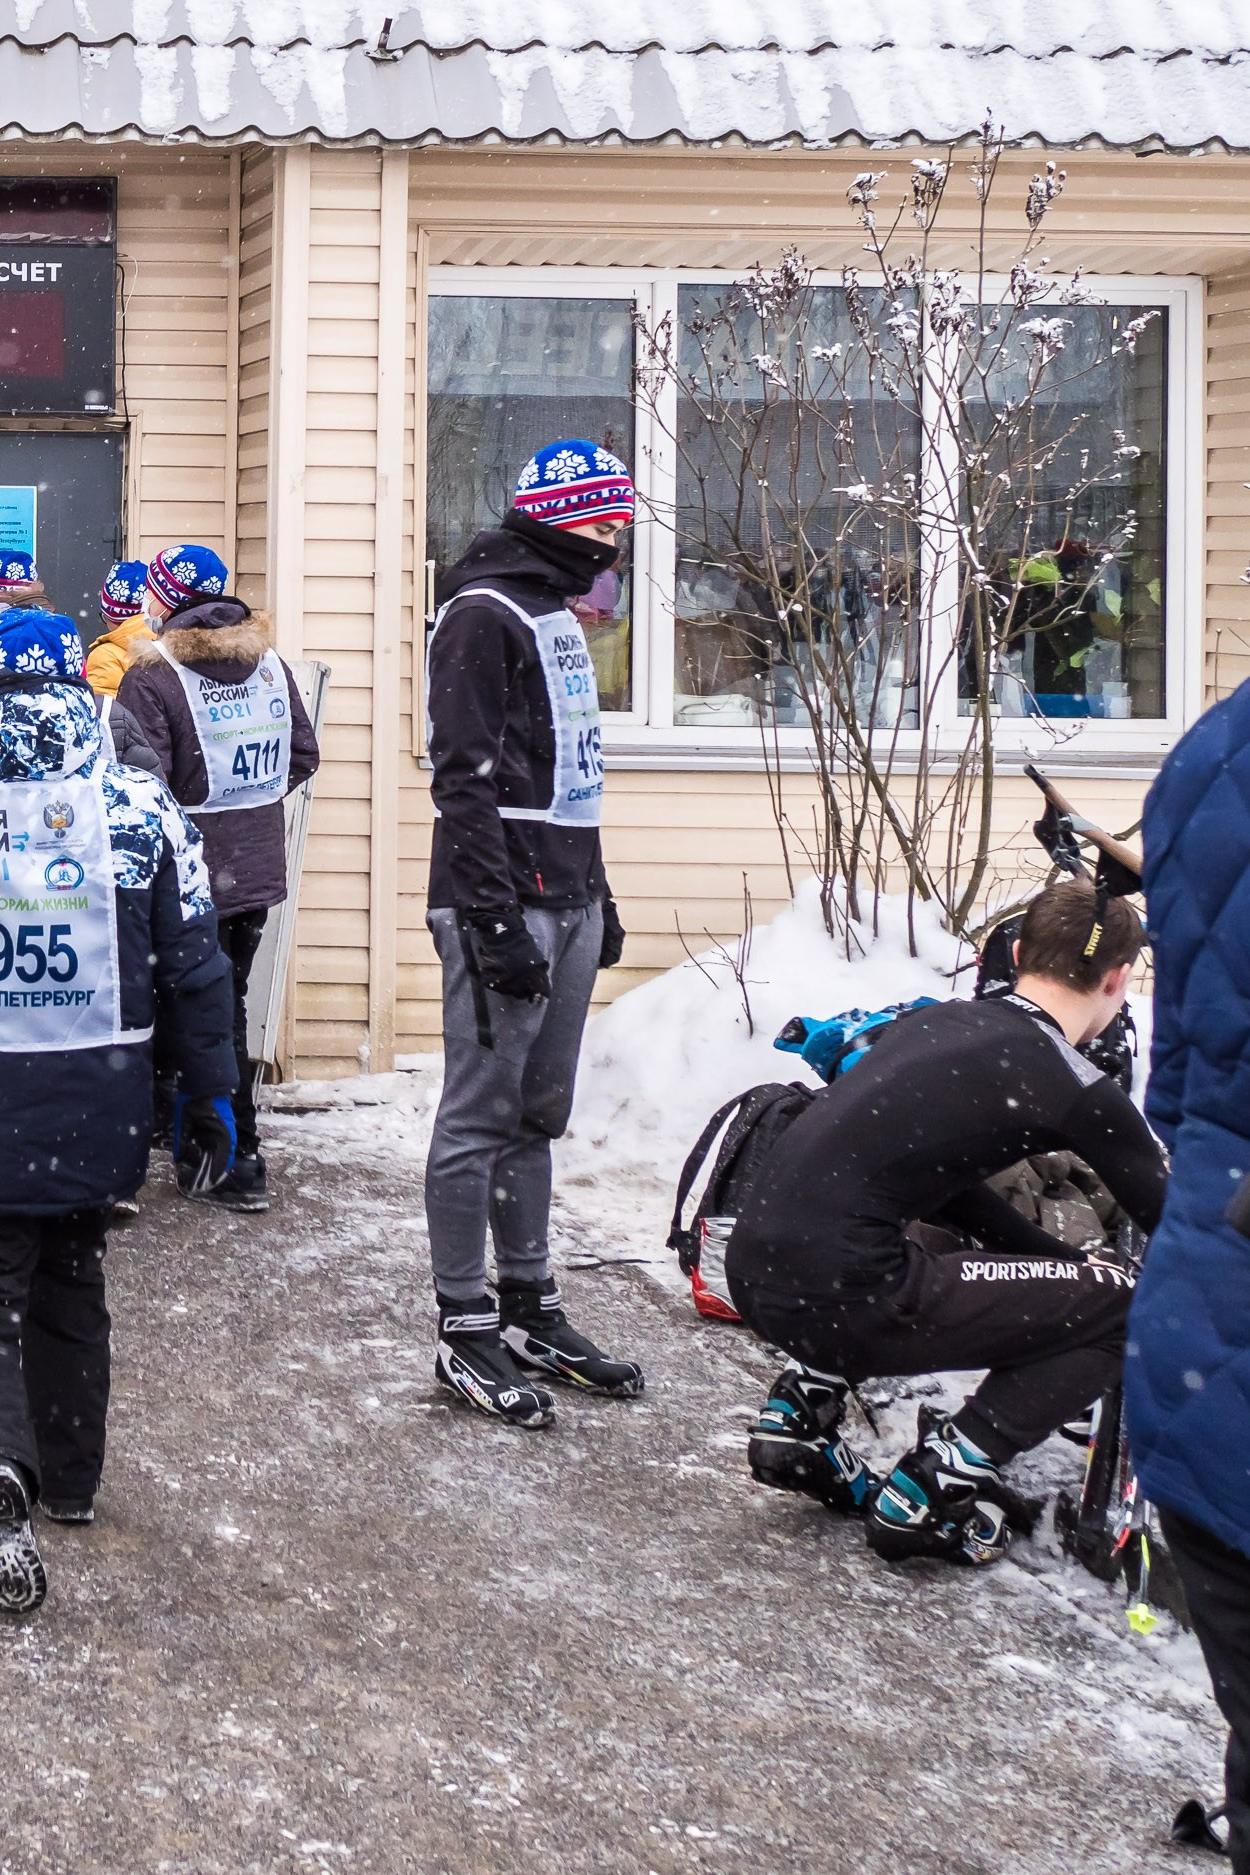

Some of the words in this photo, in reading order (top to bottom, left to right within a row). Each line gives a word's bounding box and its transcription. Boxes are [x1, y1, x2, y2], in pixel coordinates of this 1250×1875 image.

[201, 685, 250, 705] РОССИИ
[208, 702, 252, 723] 2021
[232, 737, 280, 781] 4711
[41, 896, 89, 911] ЖИЗНИ
[961, 1261, 1080, 1282] SPORTSWEAR
